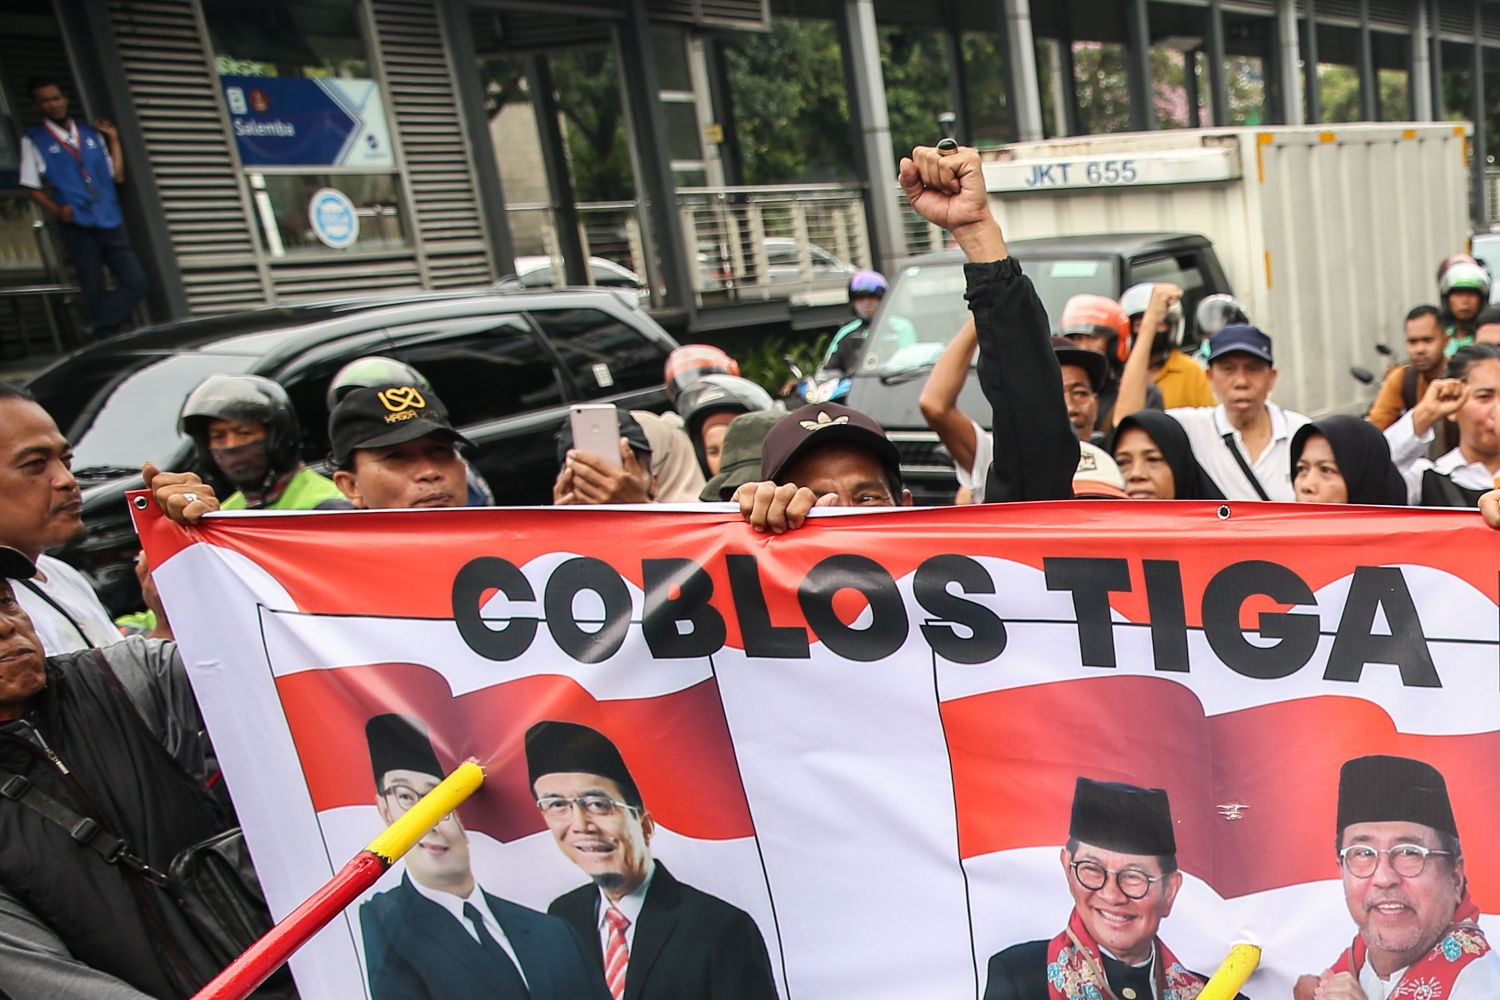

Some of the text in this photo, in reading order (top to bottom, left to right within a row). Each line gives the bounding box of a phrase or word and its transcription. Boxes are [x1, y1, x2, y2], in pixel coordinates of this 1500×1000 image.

[234, 117, 295, 137] Salemba
[1025, 160, 1137, 187] JKT 655
[452, 553, 1007, 665] COBLOS
[1043, 557, 1443, 689] TIGA
